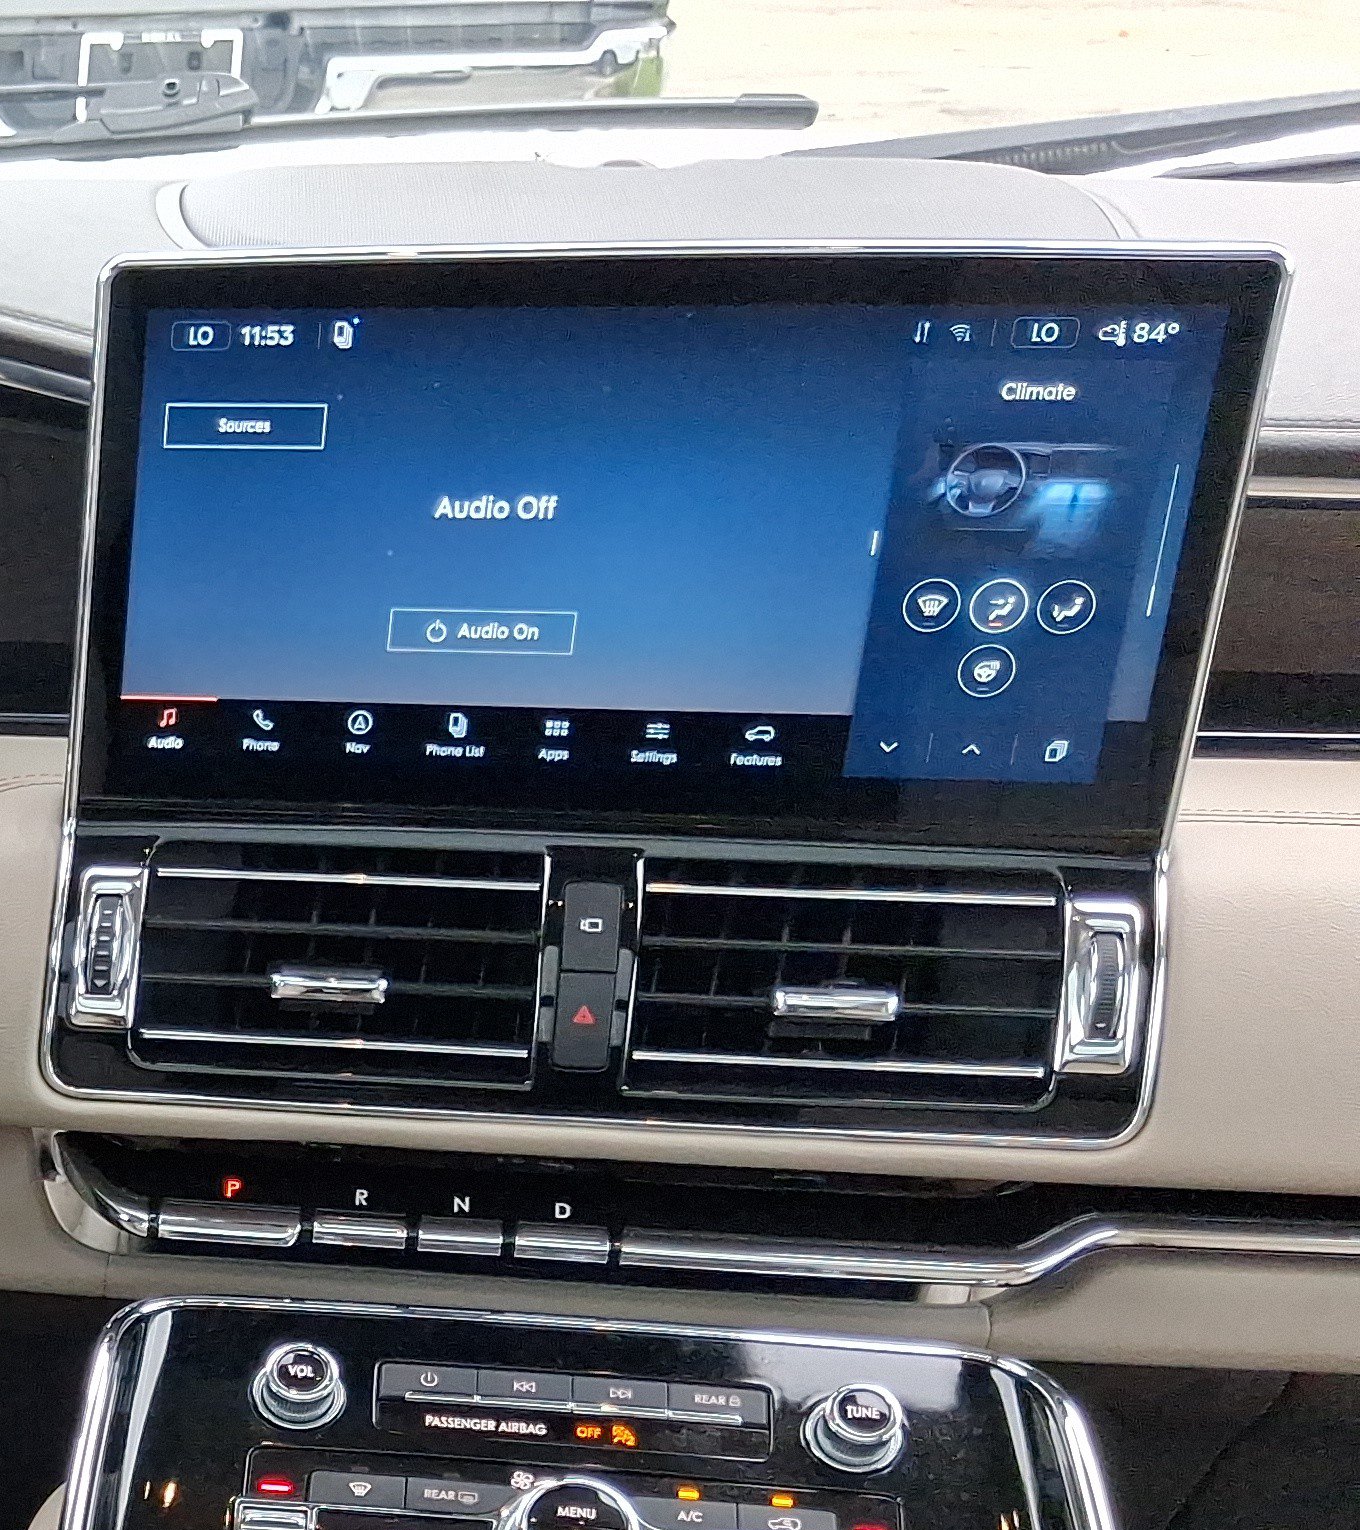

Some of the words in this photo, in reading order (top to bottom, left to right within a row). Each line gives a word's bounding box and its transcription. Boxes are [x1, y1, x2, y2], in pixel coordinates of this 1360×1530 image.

[188, 326, 214, 346] LO
[241, 326, 294, 347] 11:53
[1030, 322, 1059, 343] LO
[1001, 382, 1076, 401] Climate
[218, 417, 271, 434] Sources
[434, 496, 509, 520] Audio
[516, 495, 558, 520] Off
[457, 622, 508, 641] Audio
[512, 622, 539, 641] On
[147, 736, 184, 750] Audio
[243, 738, 280, 751] Phone
[345, 742, 371, 754] Nav
[425, 744, 463, 757] Phone
[465, 745, 485, 758] List
[538, 749, 570, 762] Apps
[630, 750, 678, 765] Settings
[730, 753, 782, 767] Features
[225, 1179, 241, 1198] P
[354, 1189, 369, 1206] R
[453, 1197, 470, 1214] N
[555, 1203, 571, 1219] D
[287, 1364, 315, 1378] VOL
[694, 1394, 726, 1406] REAR
[846, 1404, 880, 1420] TUNE
[424, 1414, 496, 1432] PASSENGER
[498, 1420, 548, 1436] AIRBAG
[576, 1425, 602, 1440] OFF
[423, 1488, 456, 1501] REAR
[556, 1505, 597, 1521] MENU
[677, 1510, 704, 1523] A/C
